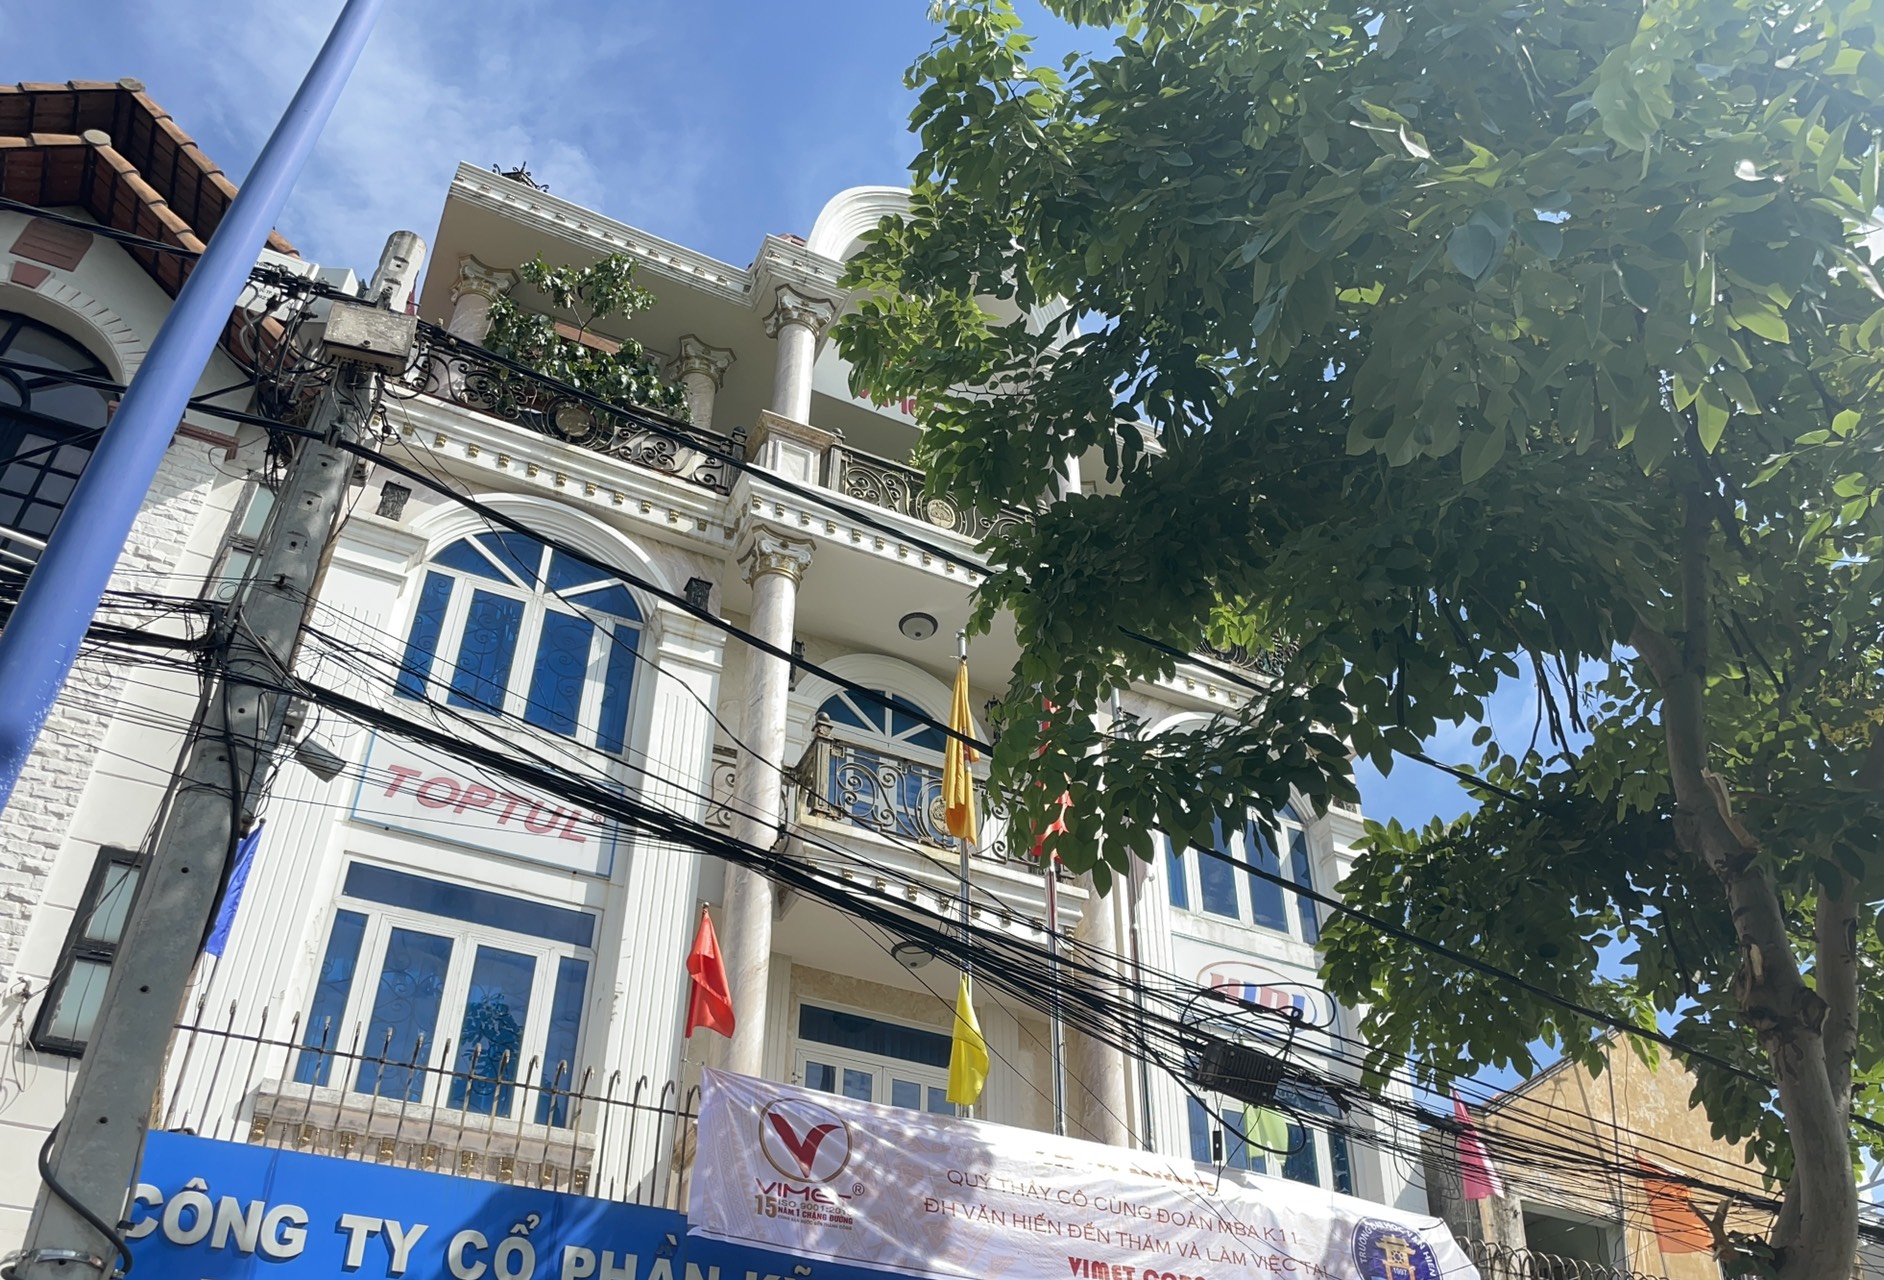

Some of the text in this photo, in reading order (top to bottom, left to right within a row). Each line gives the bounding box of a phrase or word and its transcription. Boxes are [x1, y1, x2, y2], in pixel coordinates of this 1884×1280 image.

[383, 764, 587, 844] TOPTUL
[120, 1176, 310, 1259] CÔNG
[341, 1213, 429, 1274] TY
[754, 1194, 778, 1219] 15
[924, 1197, 1328, 1280] ĐH VĂN HIẾN ĐẾN THĂM VÀ LÀM VIỆC TẠI
[946, 1168, 990, 1190] QUÝ
[1057, 1189, 1088, 1208] CÔ
[1094, 1196, 1152, 1220] CÙNG
[1157, 1209, 1213, 1232] ĐOÀN
[1218, 1220, 1260, 1239] MBA
